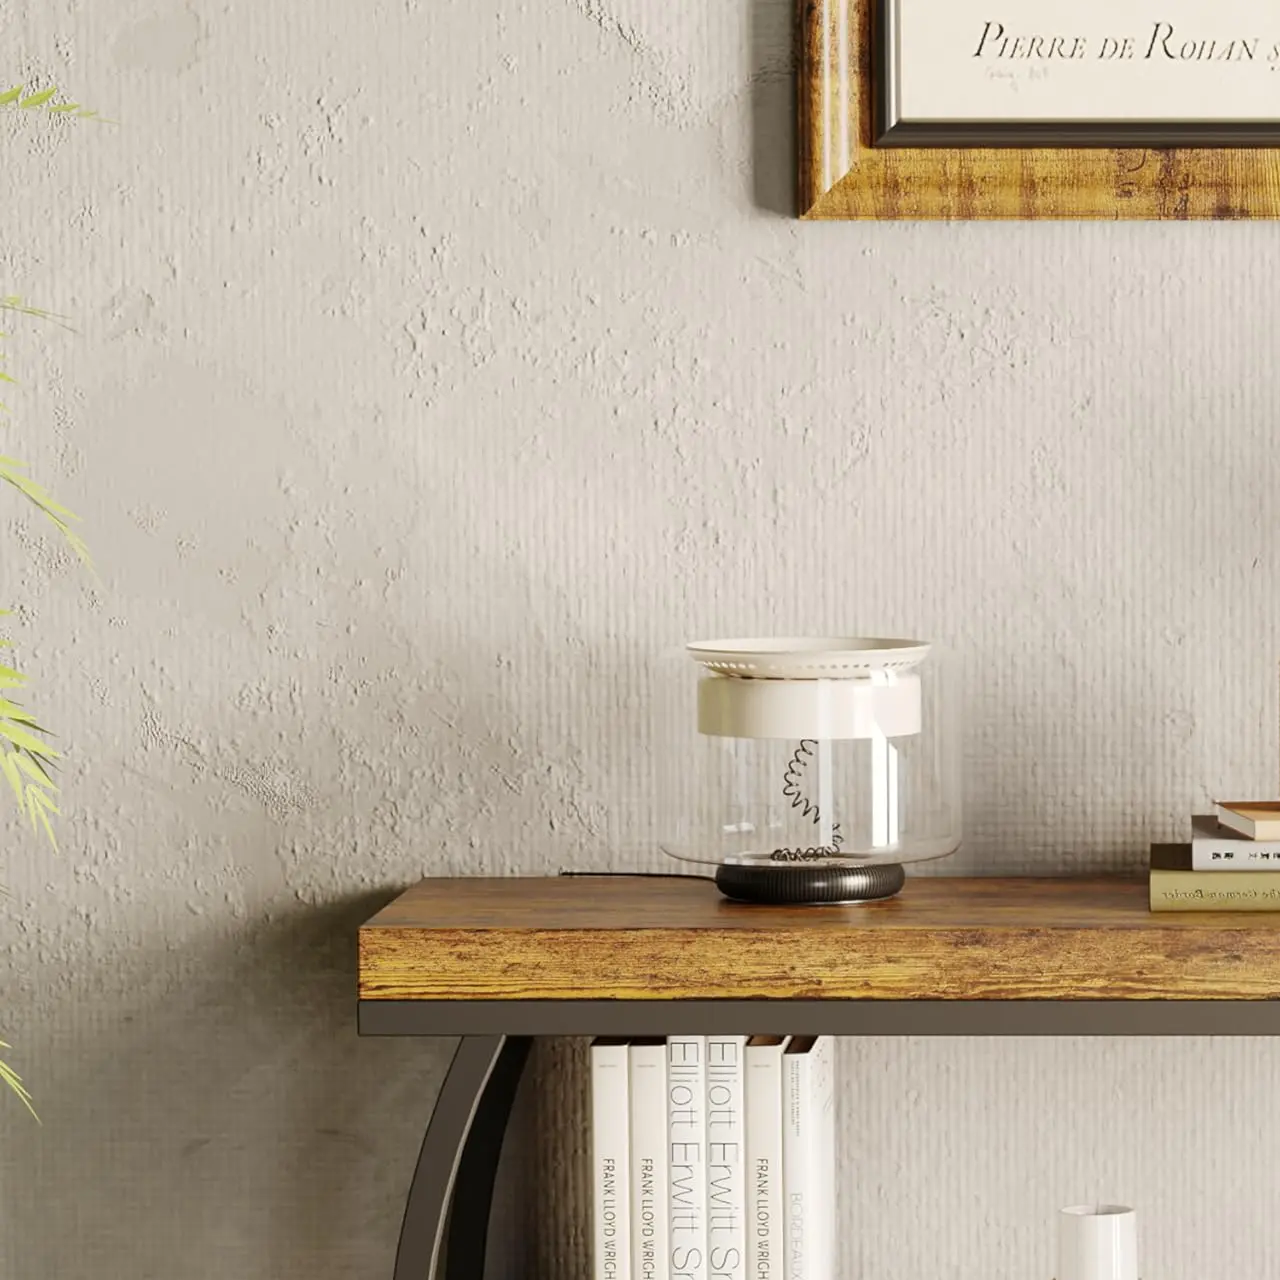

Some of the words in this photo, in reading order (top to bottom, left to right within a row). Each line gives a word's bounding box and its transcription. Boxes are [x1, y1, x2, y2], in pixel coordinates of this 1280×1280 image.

[972, 21, 1087, 59] PIERRE
[1099, 37, 1136, 60] DE
[1144, 21, 1259, 60] ROHAN
[670, 1042, 699, 1128] Elliott
[708, 1042, 738, 1128] Elliott
[603, 1158, 615, 1196] FRANK
[642, 1158, 654, 1196] FRANK
[672, 1142, 701, 1234] Erwitt
[710, 1142, 739, 1234] Erwitt
[756, 1158, 768, 1196] FRANK
[604, 1199, 616, 1237] LLOYD
[642, 1199, 654, 1237] LLOYD
[757, 1199, 770, 1237] LLOYD
